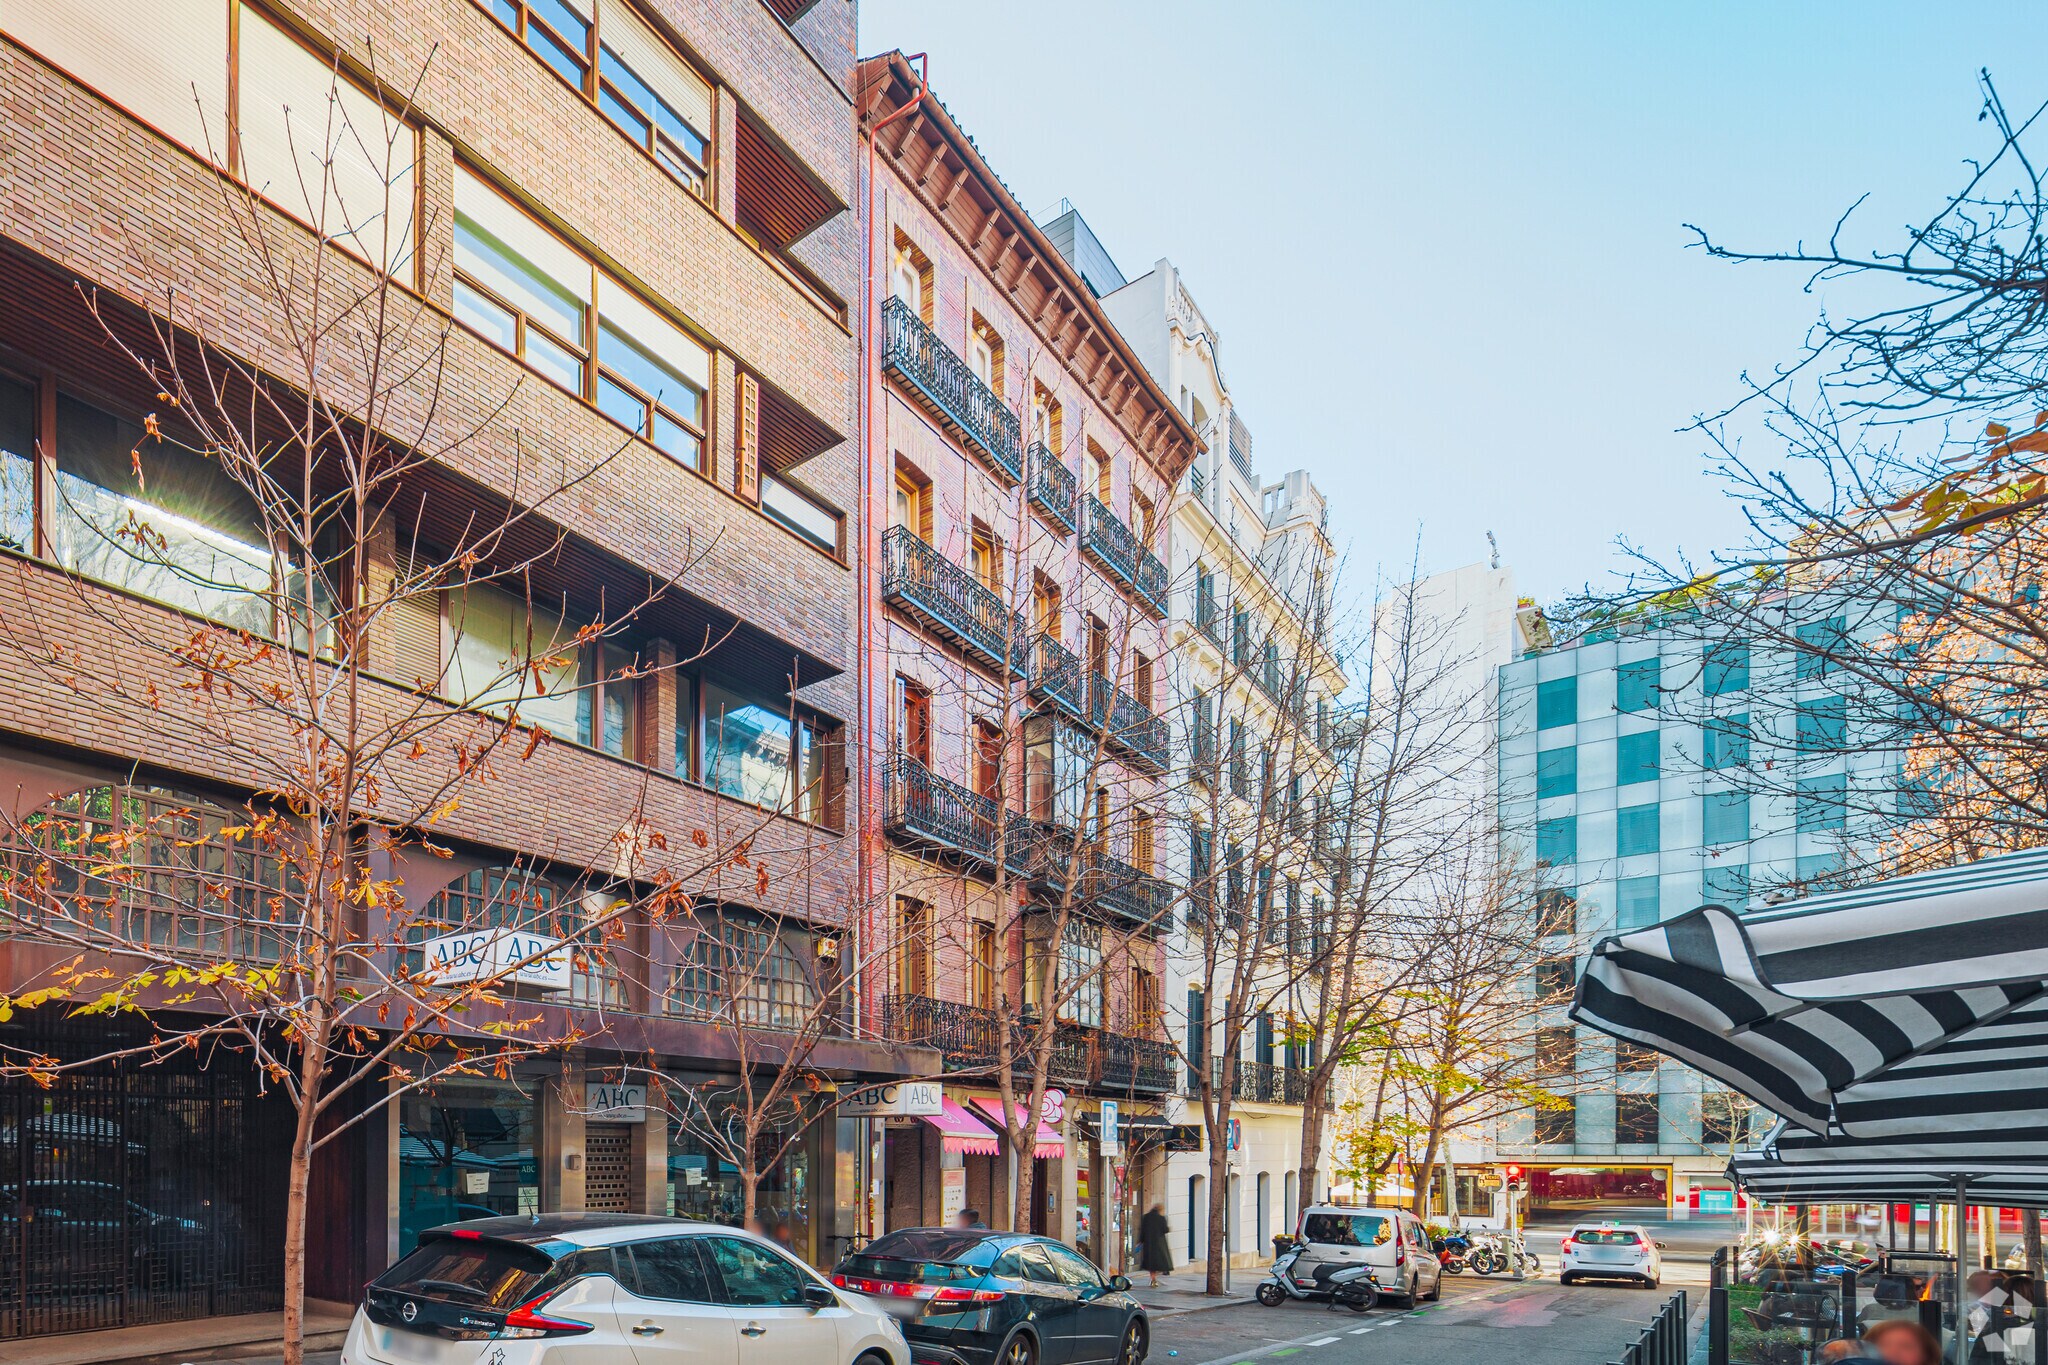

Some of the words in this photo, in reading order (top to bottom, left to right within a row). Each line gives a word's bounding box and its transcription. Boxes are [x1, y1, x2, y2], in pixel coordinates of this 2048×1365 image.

[437, 936, 487, 967] ABC
[505, 937, 563, 971] ABC
[595, 1087, 639, 1110] ABC
[847, 1085, 897, 1107] ABC
[910, 1085, 937, 1105] ABC
[521, 1165, 536, 1173] ABC
